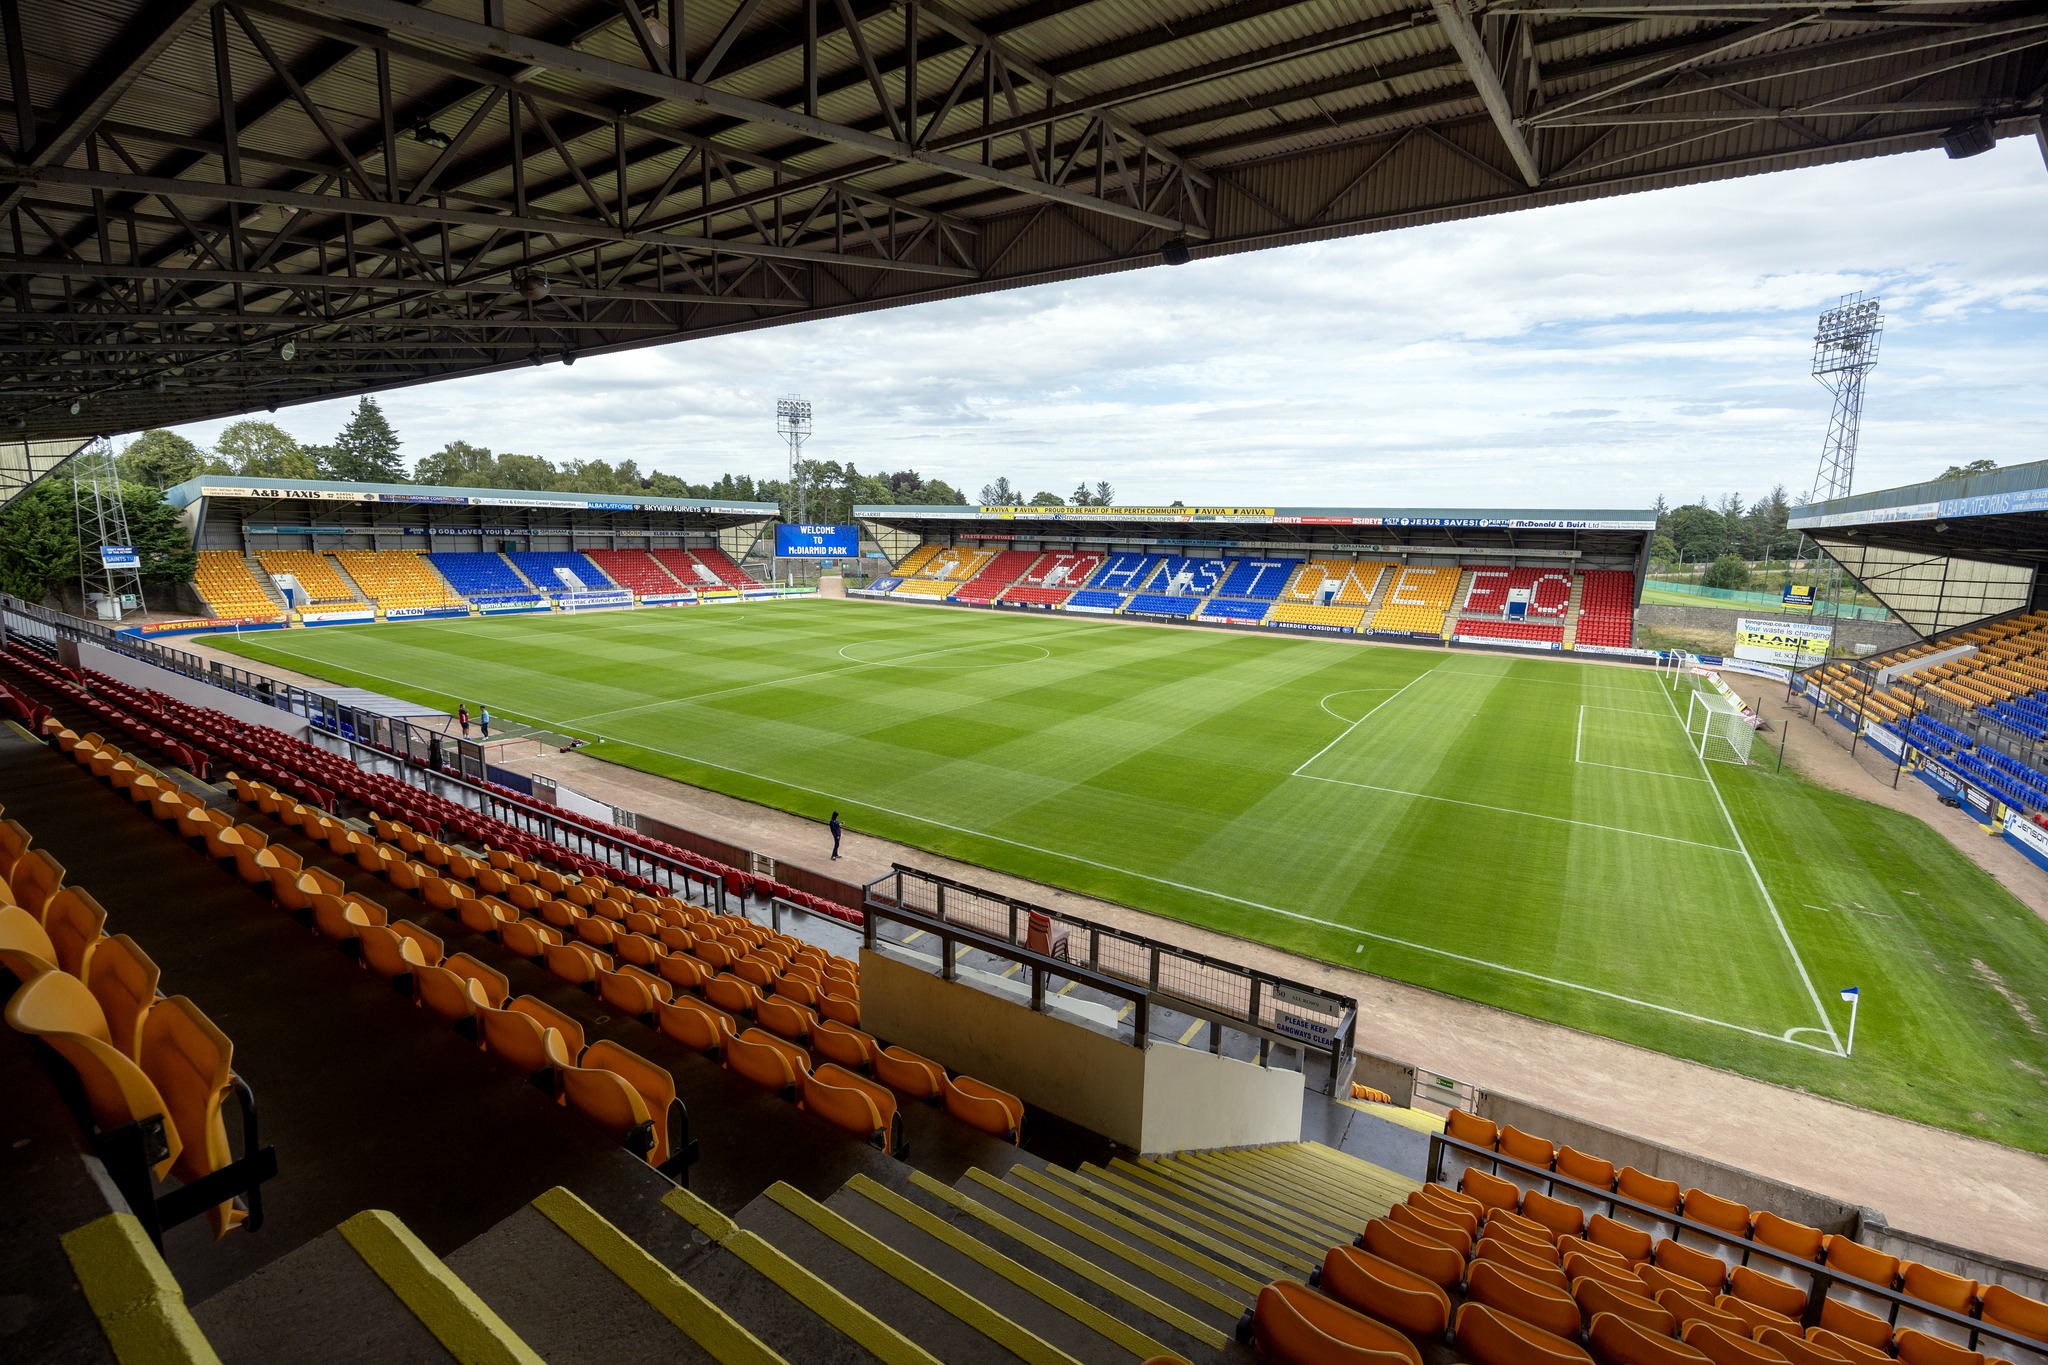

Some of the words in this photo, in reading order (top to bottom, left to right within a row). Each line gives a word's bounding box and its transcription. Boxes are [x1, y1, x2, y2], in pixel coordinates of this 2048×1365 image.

[251, 489, 279, 497] A&B
[284, 490, 321, 498] TAXIS
[1937, 501, 1957, 516] ALBA
[1958, 494, 2010, 515] PLATFORMS
[1357, 517, 1378, 525] SIDEY
[800, 526, 835, 535] WELCOME
[813, 536, 823, 544] TO
[788, 546, 826, 555] McDIARMID
[828, 546, 847, 555] PARK
[395, 608, 424, 616] ALTON
[1202, 615, 1223, 623] SIDEY
[1745, 619, 1791, 628] binngroup.co.uk
[159, 623, 182, 631] PEPE'S
[182, 621, 209, 629] PERTH
[1278, 622, 1307, 630] ABERDEIN
[1308, 624, 1341, 632] CONSIDINE
[1744, 624, 1761, 632] Your
[1794, 630, 1831, 641] changing
[1747, 633, 1811, 645] PLANT
[1926, 759, 1937, 773] Shatter
[1944, 771, 1957, 786] Silence
[1303, 998, 1320, 1007] ROWS
[1284, 1015, 1309, 1030] PLEASE
[1310, 1023, 1328, 1034] KEEP
[1276, 1023, 1312, 1041] GANGWAYS
[1402, 1067, 1414, 1077] 14
[1480, 1091, 1488, 1101] 11
